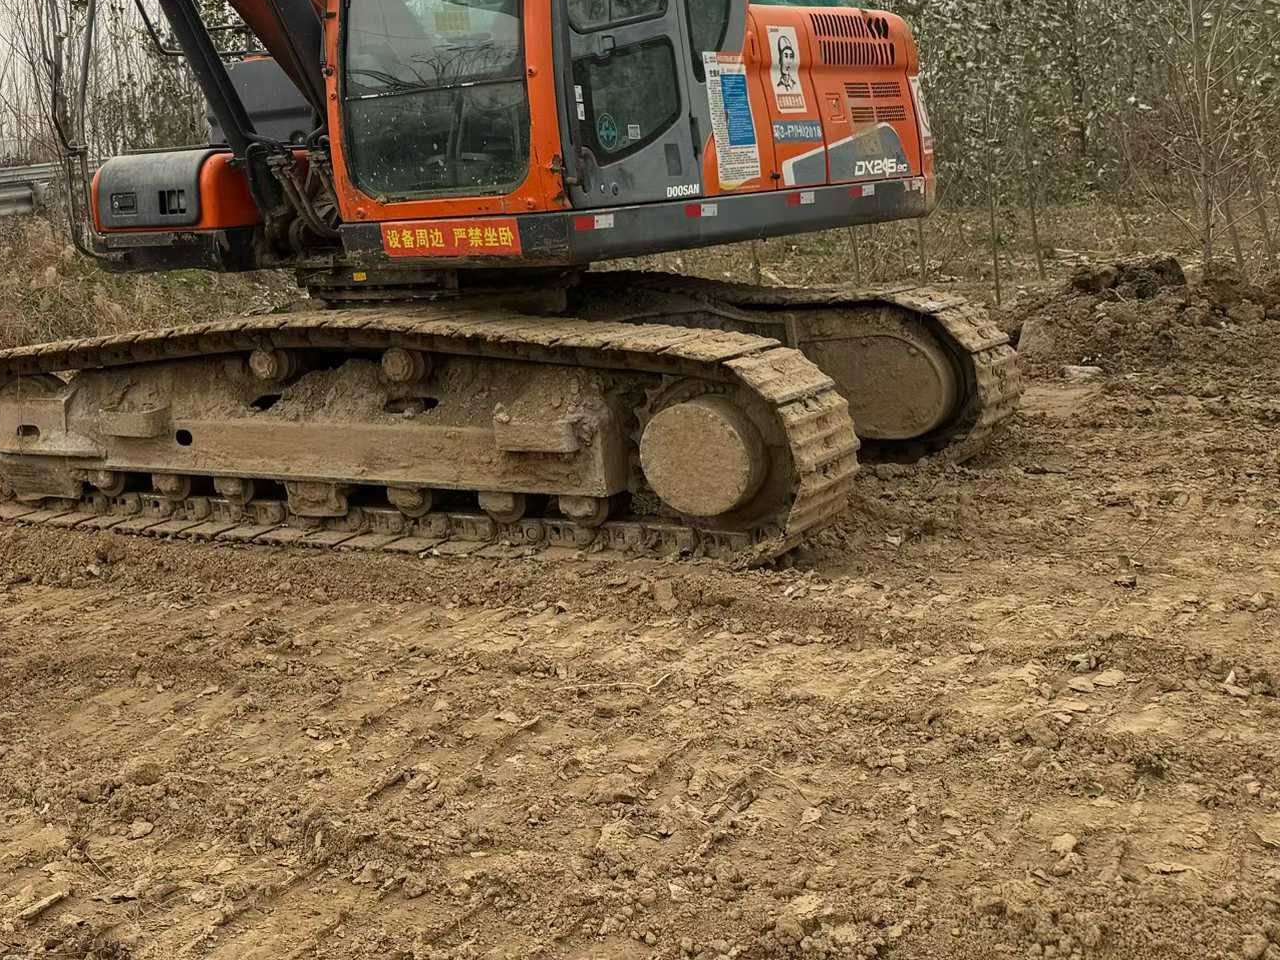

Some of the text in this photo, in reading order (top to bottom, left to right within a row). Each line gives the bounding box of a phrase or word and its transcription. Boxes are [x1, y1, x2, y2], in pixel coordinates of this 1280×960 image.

[666, 183, 700, 198] DOOSAN
[387, 226, 514, 248] 设备周边 严禁坐卧
